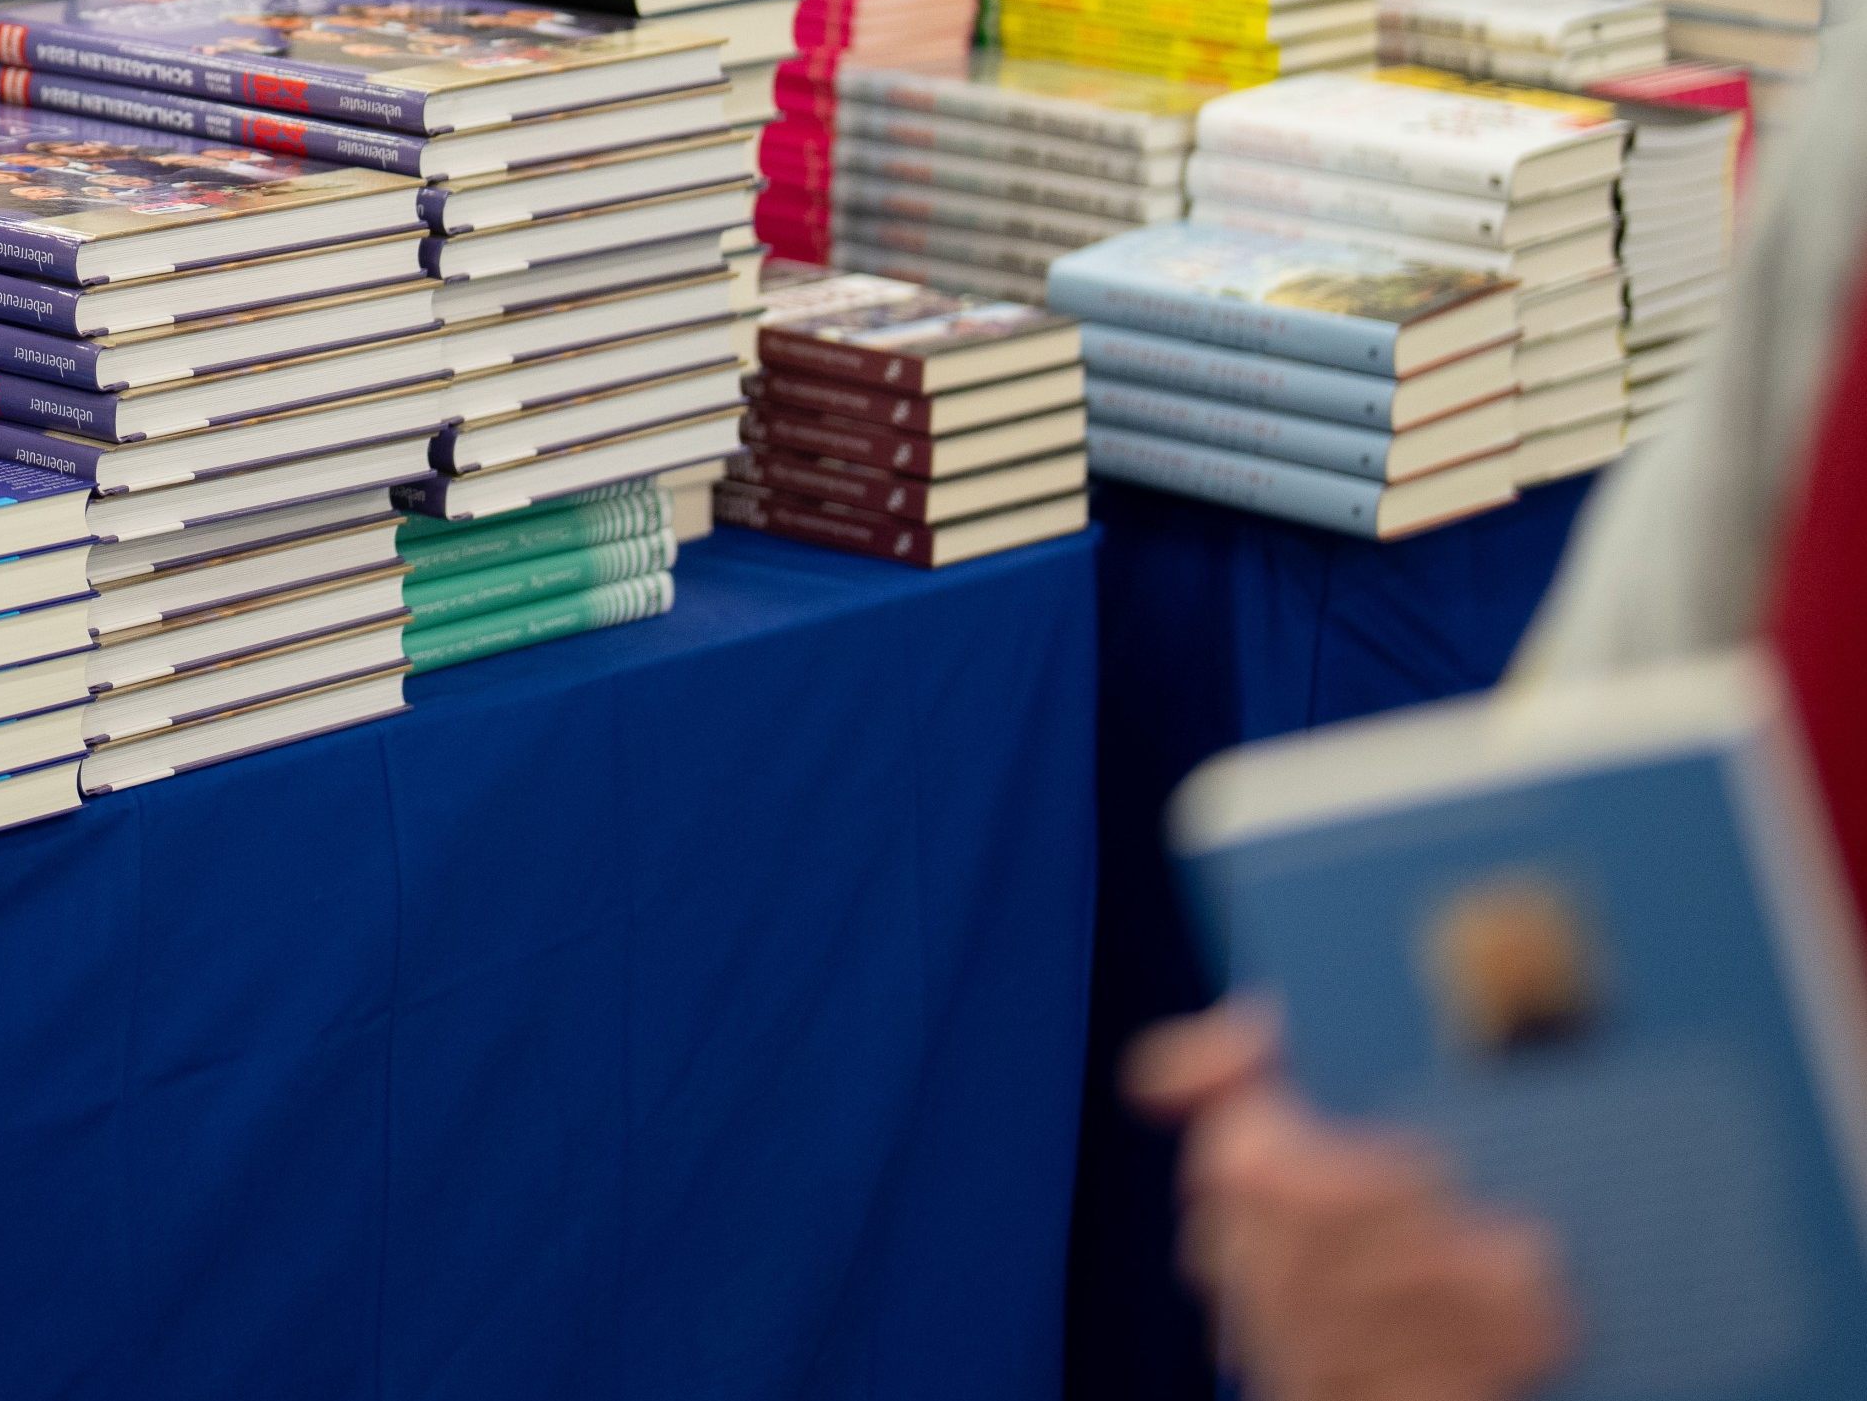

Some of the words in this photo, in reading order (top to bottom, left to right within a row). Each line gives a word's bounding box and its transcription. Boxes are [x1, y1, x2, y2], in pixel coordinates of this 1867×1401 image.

[338, 95, 402, 125] ueberreuter
[336, 139, 400, 169] ueberreuter
[13, 346, 76, 378] ueberreuter
[29, 398, 93, 430] ueberreuter
[14, 448, 76, 475] ueberreuter
